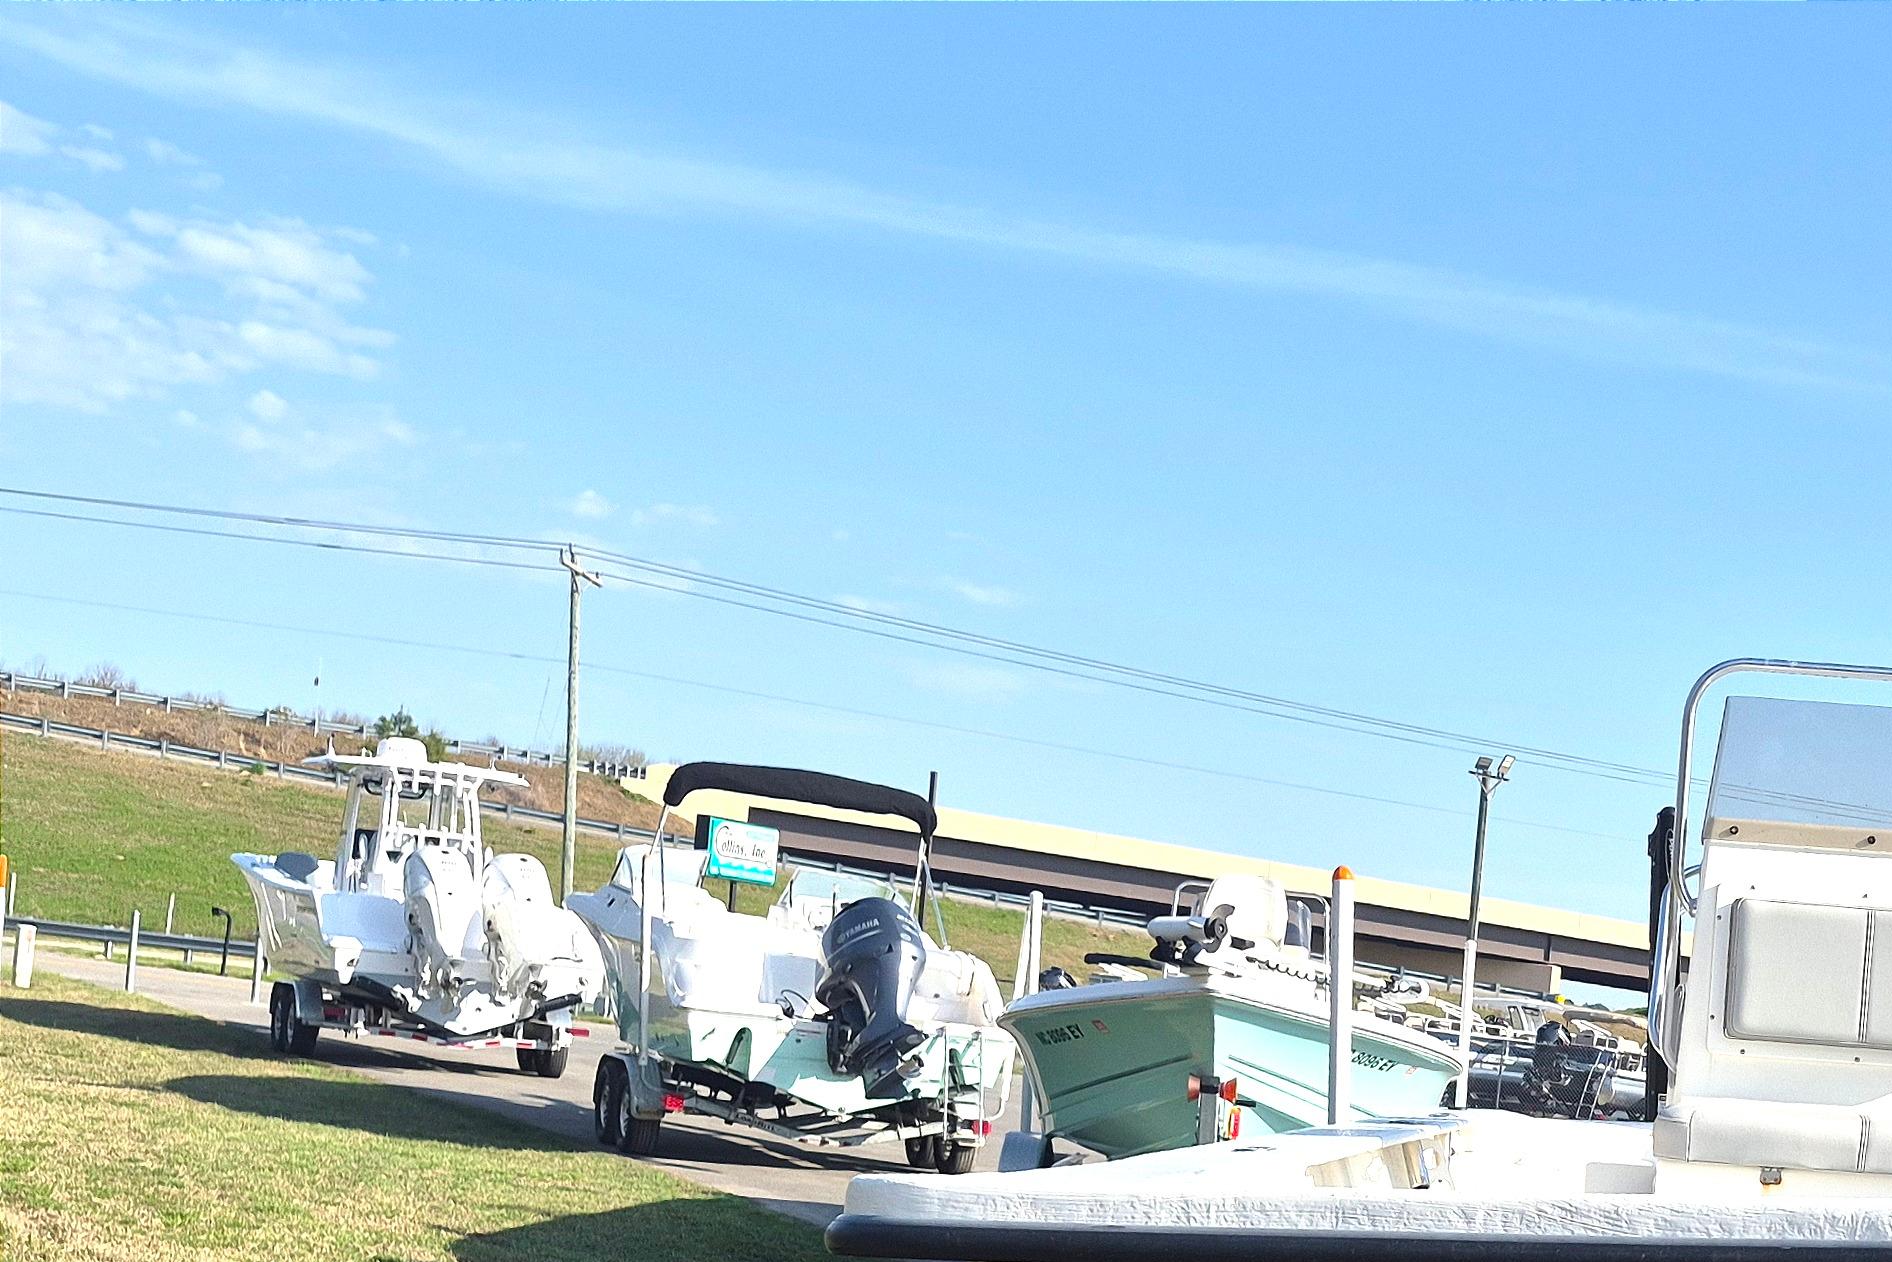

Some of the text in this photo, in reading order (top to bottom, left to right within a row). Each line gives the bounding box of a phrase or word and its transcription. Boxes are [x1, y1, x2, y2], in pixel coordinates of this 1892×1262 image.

[716, 825, 748, 859] Collins,
[845, 918, 880, 938] YAMAHA
[1066, 1023, 1085, 1039] EY
[1351, 1051, 1400, 1072] 8096 EY
